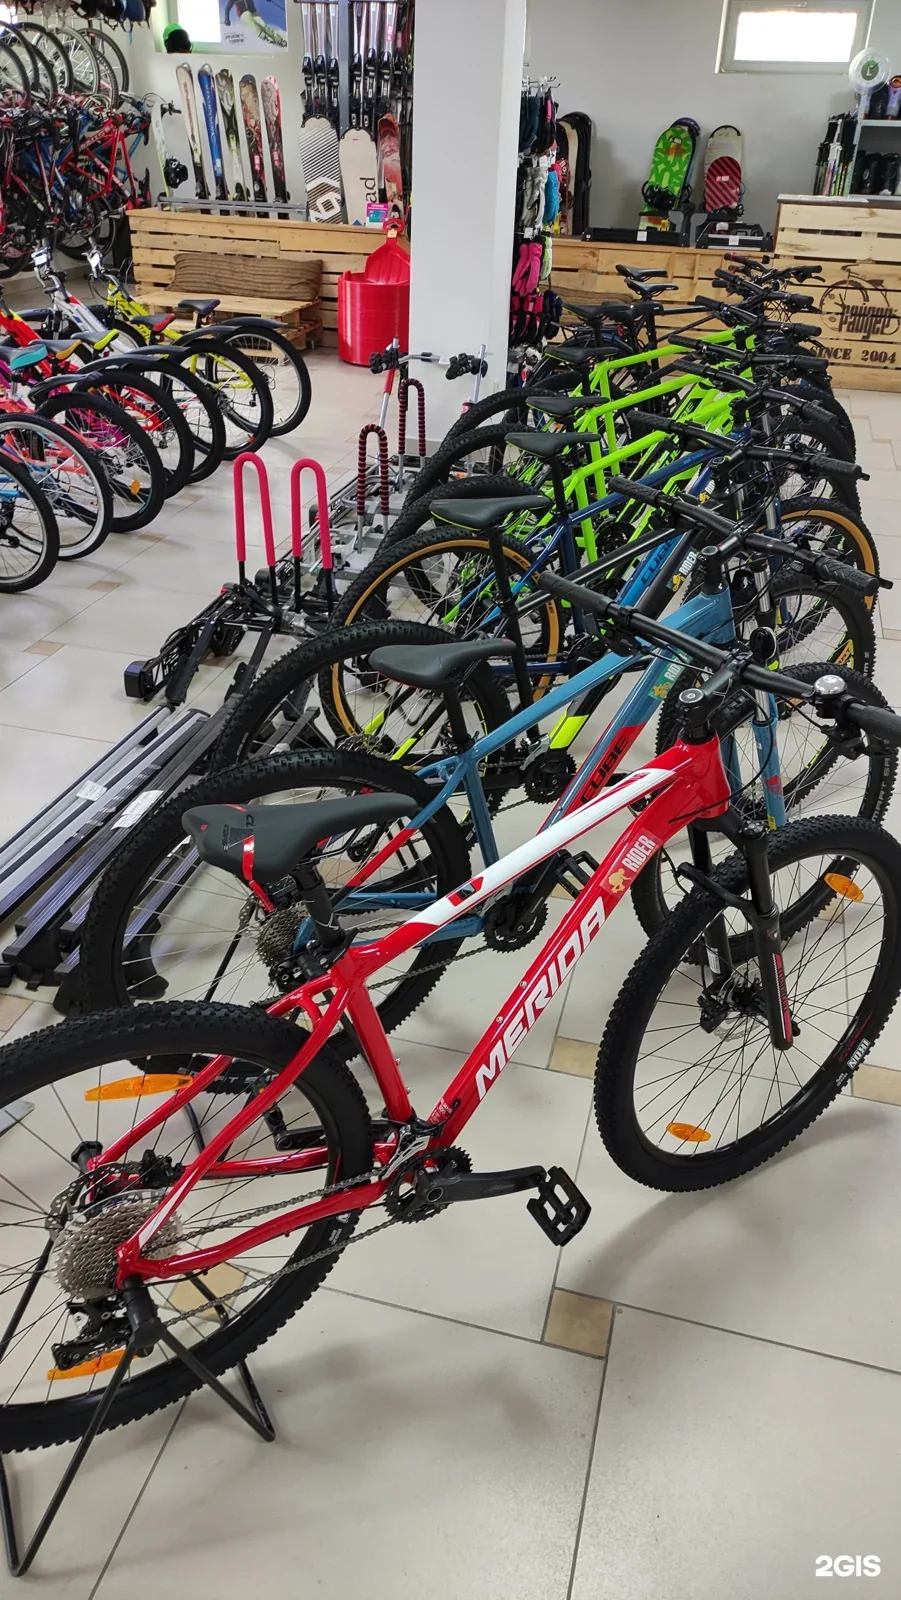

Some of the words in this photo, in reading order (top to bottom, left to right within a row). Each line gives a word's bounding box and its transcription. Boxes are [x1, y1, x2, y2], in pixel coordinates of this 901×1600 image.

[860, 349, 897, 364] 2004
[678, 550, 698, 576] RIDER
[580, 734, 629, 804] CUBE
[620, 834, 657, 873] RIDER
[474, 895, 606, 1101] MERIDA
[848, 1037, 871, 1070] IKON
